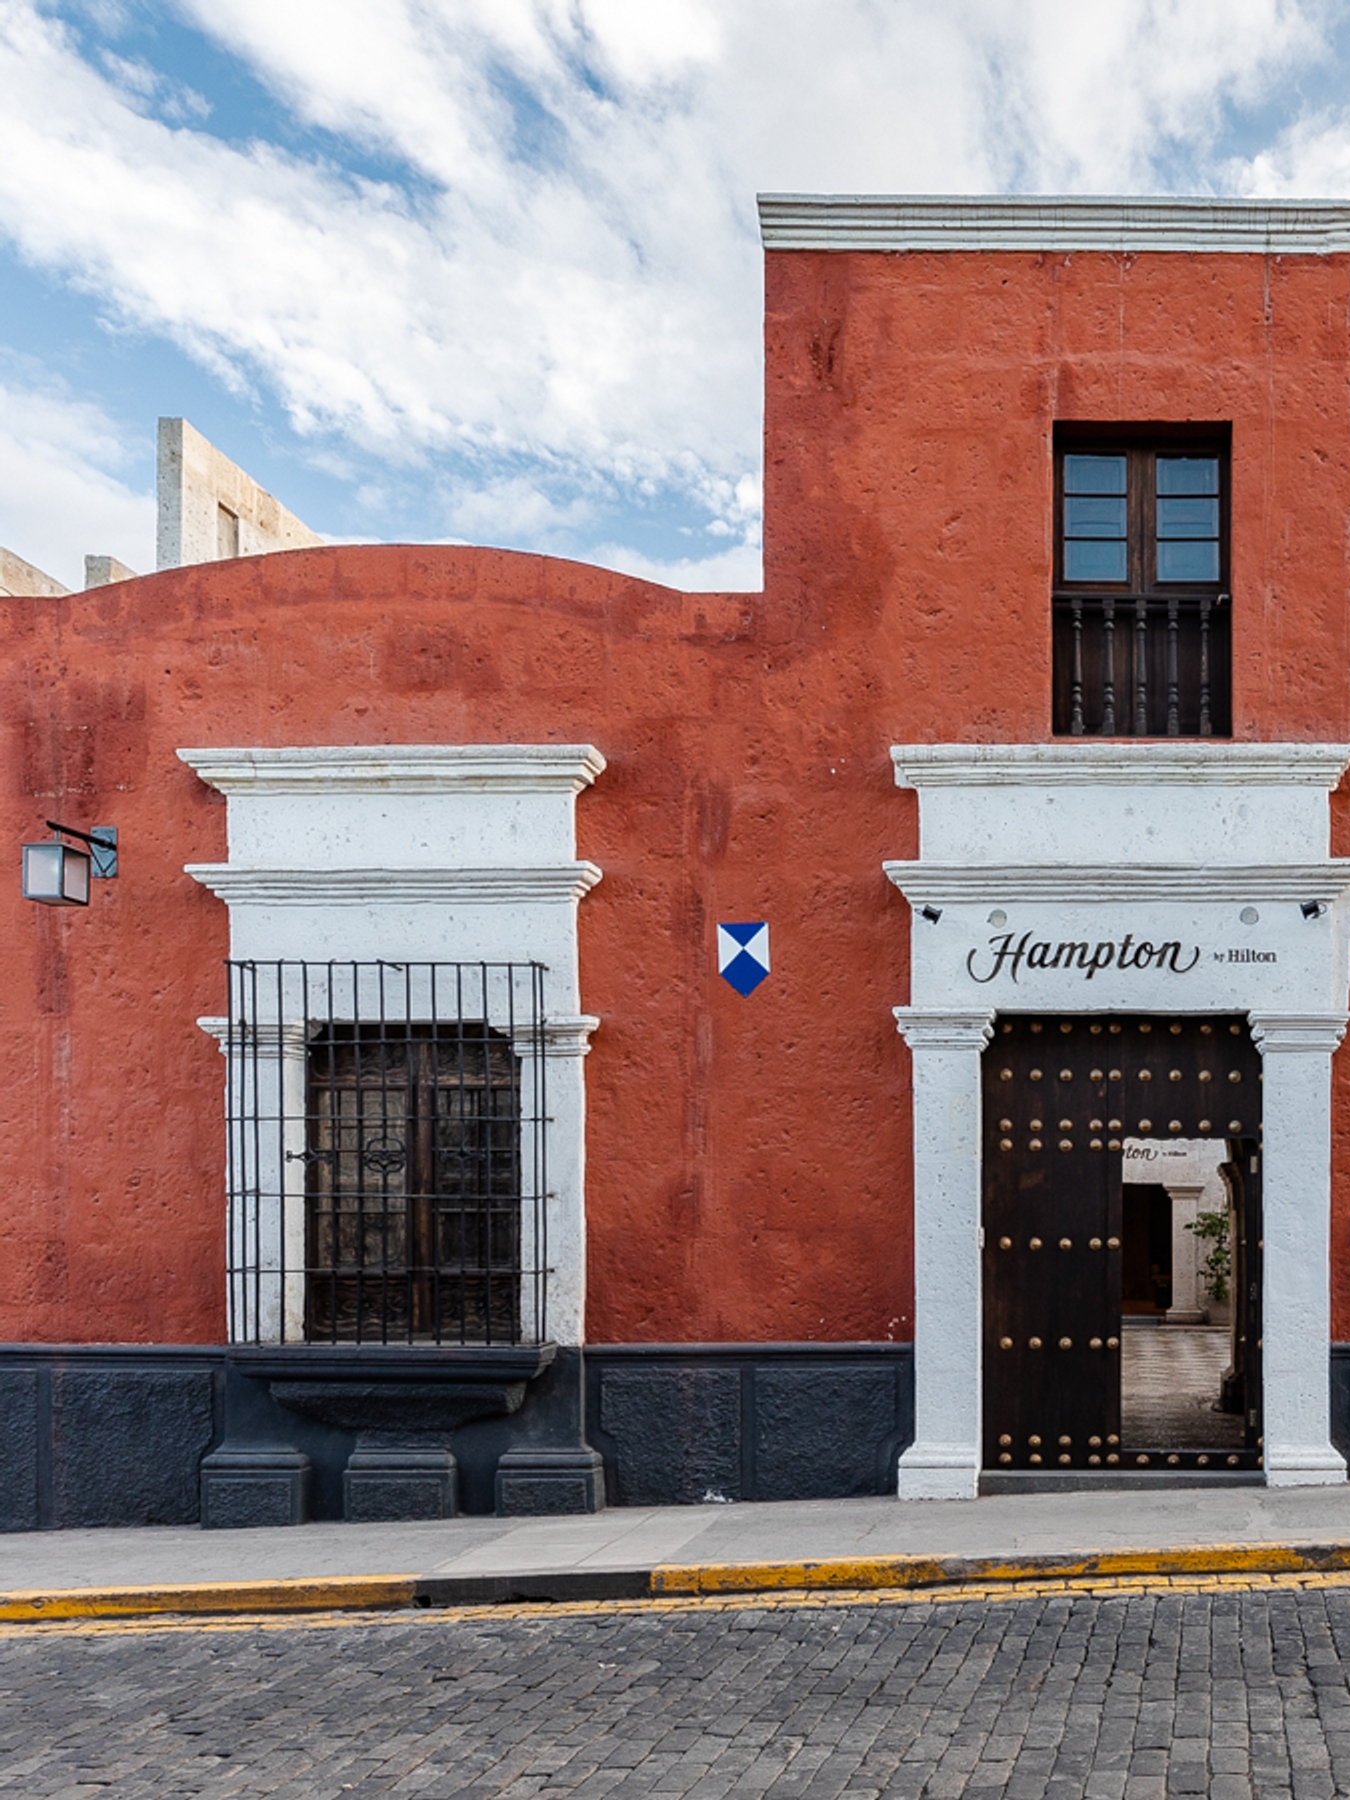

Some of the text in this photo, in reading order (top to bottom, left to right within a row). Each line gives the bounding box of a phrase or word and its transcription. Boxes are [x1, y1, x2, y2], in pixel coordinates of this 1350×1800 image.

[966, 930, 1277, 984] Hampton by Hilton
[1122, 1144, 1159, 1161] ton
